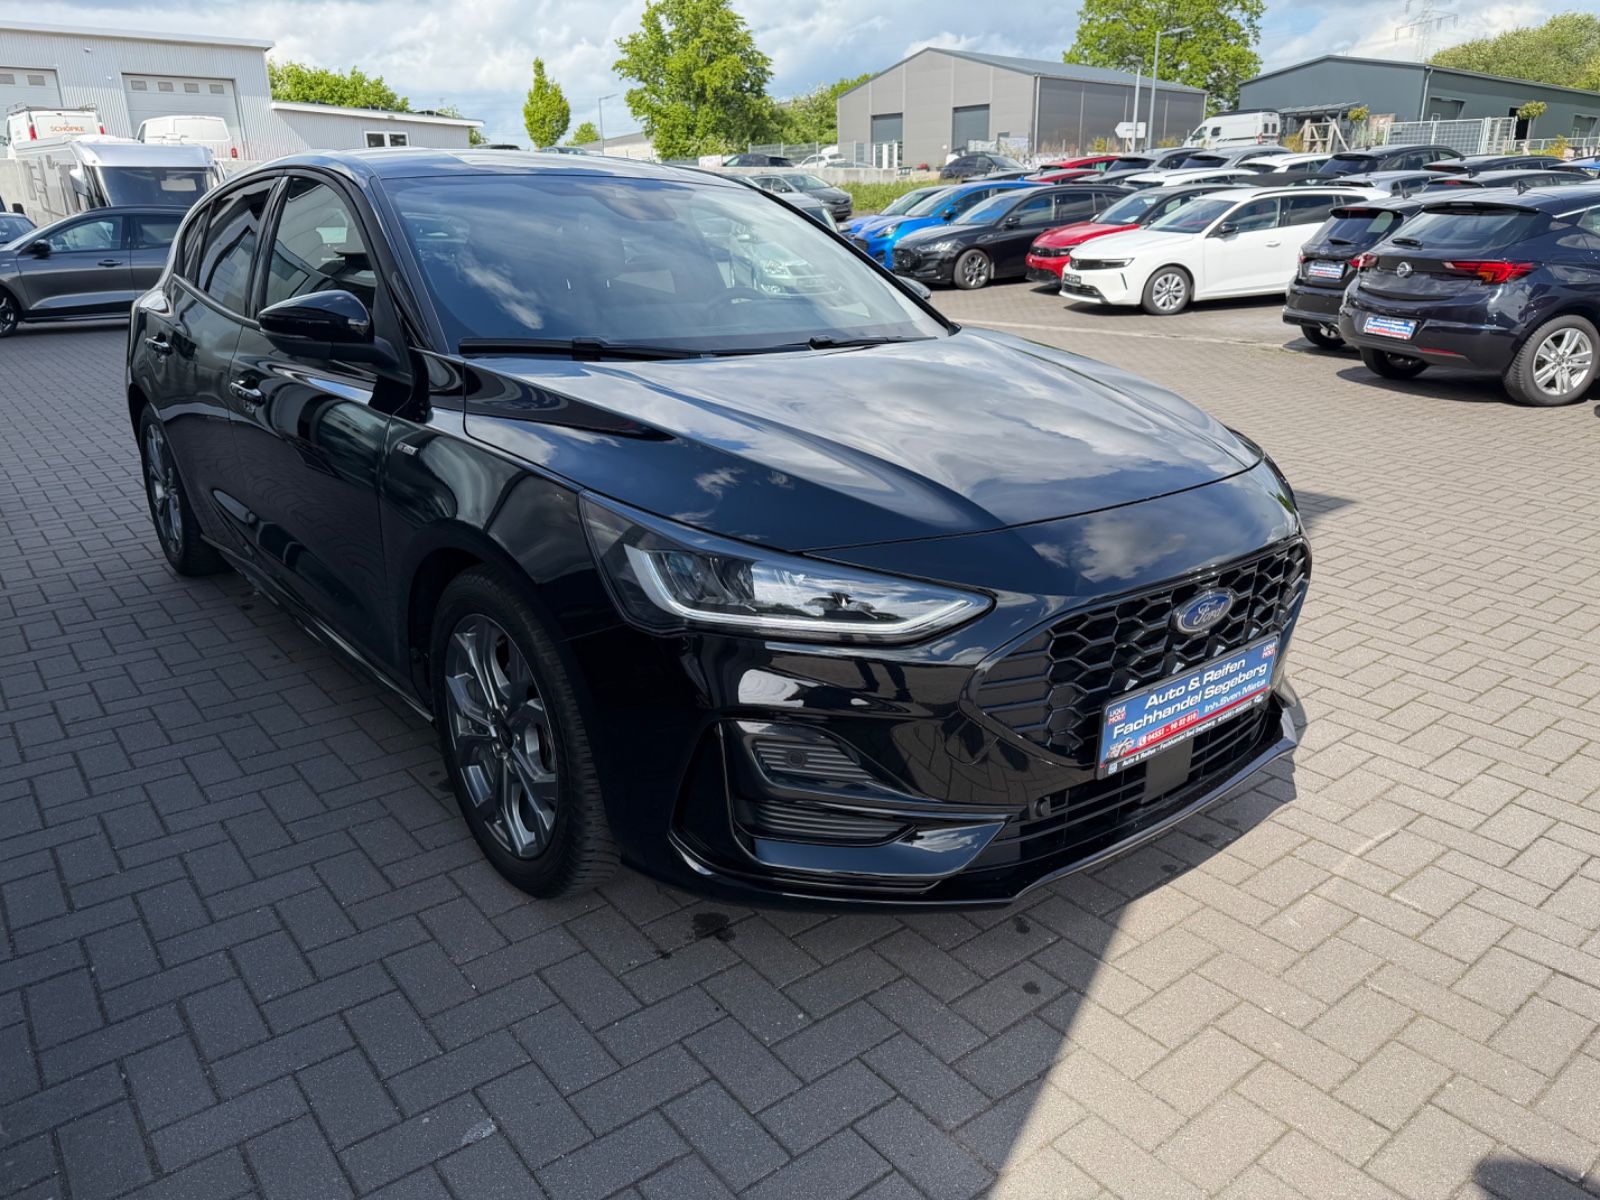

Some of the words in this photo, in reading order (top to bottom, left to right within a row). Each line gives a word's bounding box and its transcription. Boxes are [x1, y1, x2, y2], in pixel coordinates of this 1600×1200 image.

[1192, 599, 1225, 625] Ford
[1113, 690, 1202, 739] Fachhandel
[1203, 663, 1267, 699] Segeberg
[1145, 686, 1185, 709] Auto
[1188, 677, 1200, 691] &
[1202, 659, 1246, 685] Reifen
